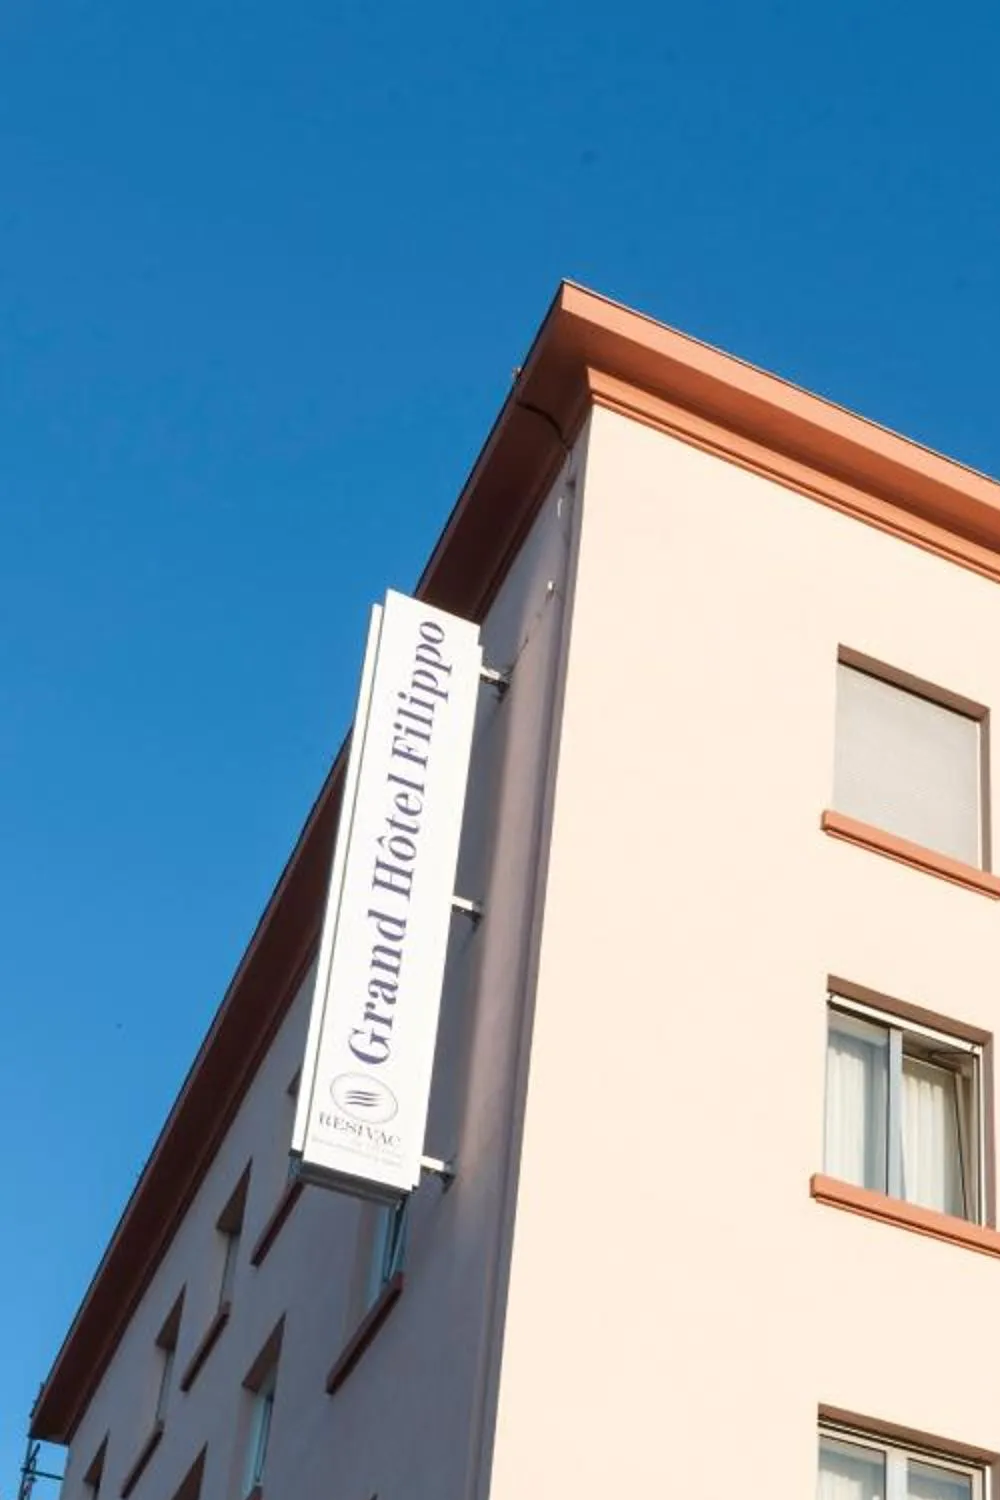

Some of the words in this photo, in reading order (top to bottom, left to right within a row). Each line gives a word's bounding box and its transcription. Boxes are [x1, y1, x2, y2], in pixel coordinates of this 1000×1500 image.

[391, 621, 453, 769] Filippo
[371, 773, 425, 900] Hôtel
[348, 908, 407, 1065] Grand
